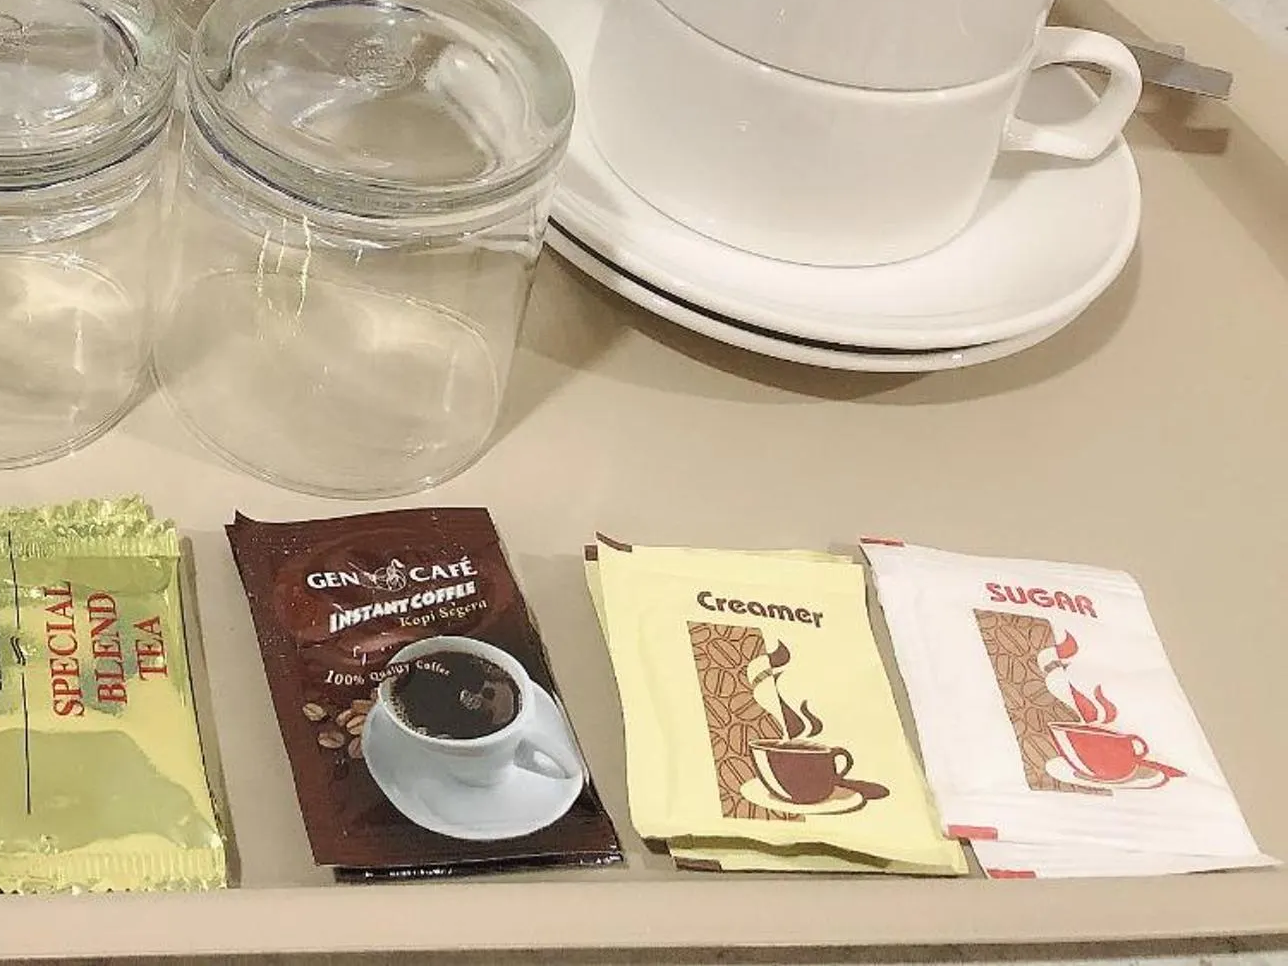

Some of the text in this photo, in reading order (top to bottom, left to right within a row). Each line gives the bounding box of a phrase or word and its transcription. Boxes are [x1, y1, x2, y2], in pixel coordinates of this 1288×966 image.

[306, 555, 478, 589] GEN CAFÉ
[329, 581, 476, 633] INSTANT COFFEE
[400, 599, 488, 627] Kopi Segera
[697, 591, 823, 628] Creamer
[986, 582, 1098, 618] SUGAR
[43, 581, 84, 716] SPECIAL
[87, 594, 127, 705] BLEND
[134, 615, 168, 680] TEA
[325, 660, 451, 685] 100% Quality Coffee
